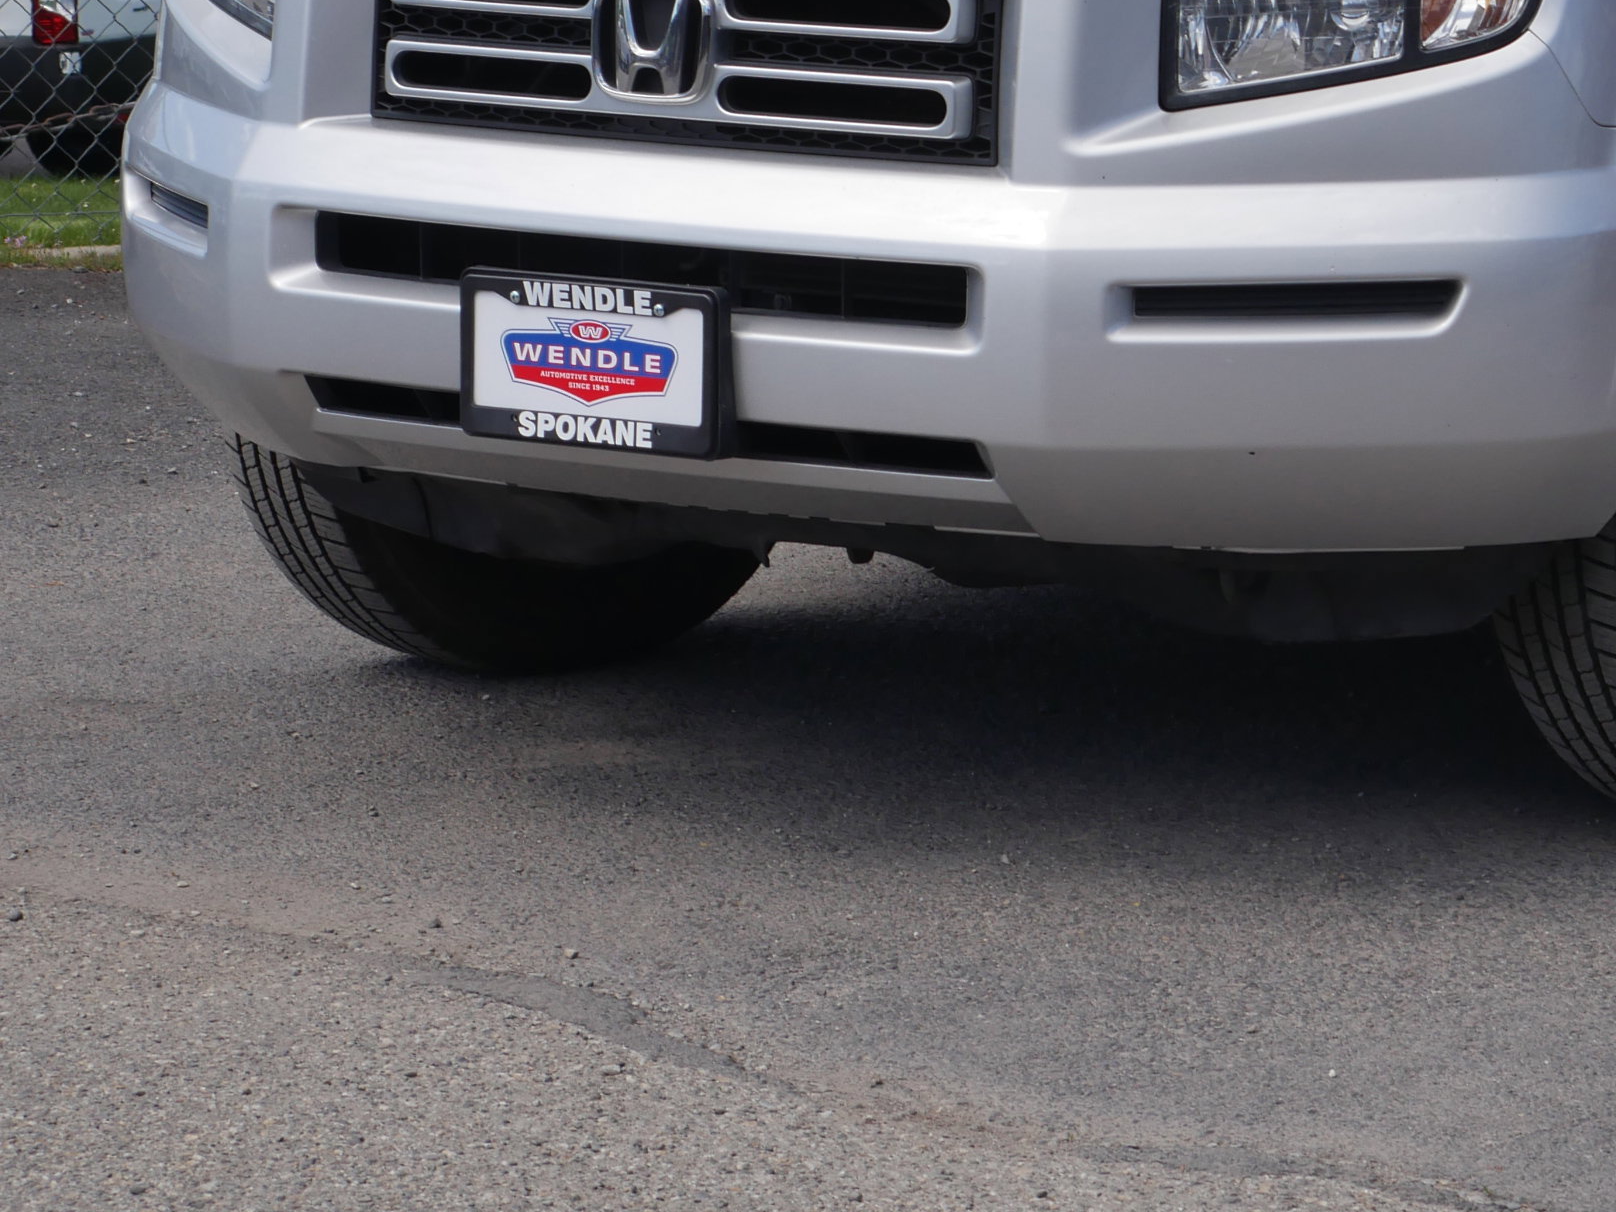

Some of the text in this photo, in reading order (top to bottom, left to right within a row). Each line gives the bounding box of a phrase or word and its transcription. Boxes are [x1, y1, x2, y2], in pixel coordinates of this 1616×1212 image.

[523, 280, 653, 316] WENDLE
[513, 342, 661, 374] WENDLE
[540, 370, 636, 386] AUTOMOTIVE EXCELLENCE
[568, 381, 610, 392] SINCE 1943
[517, 410, 653, 449] SPOKANE
